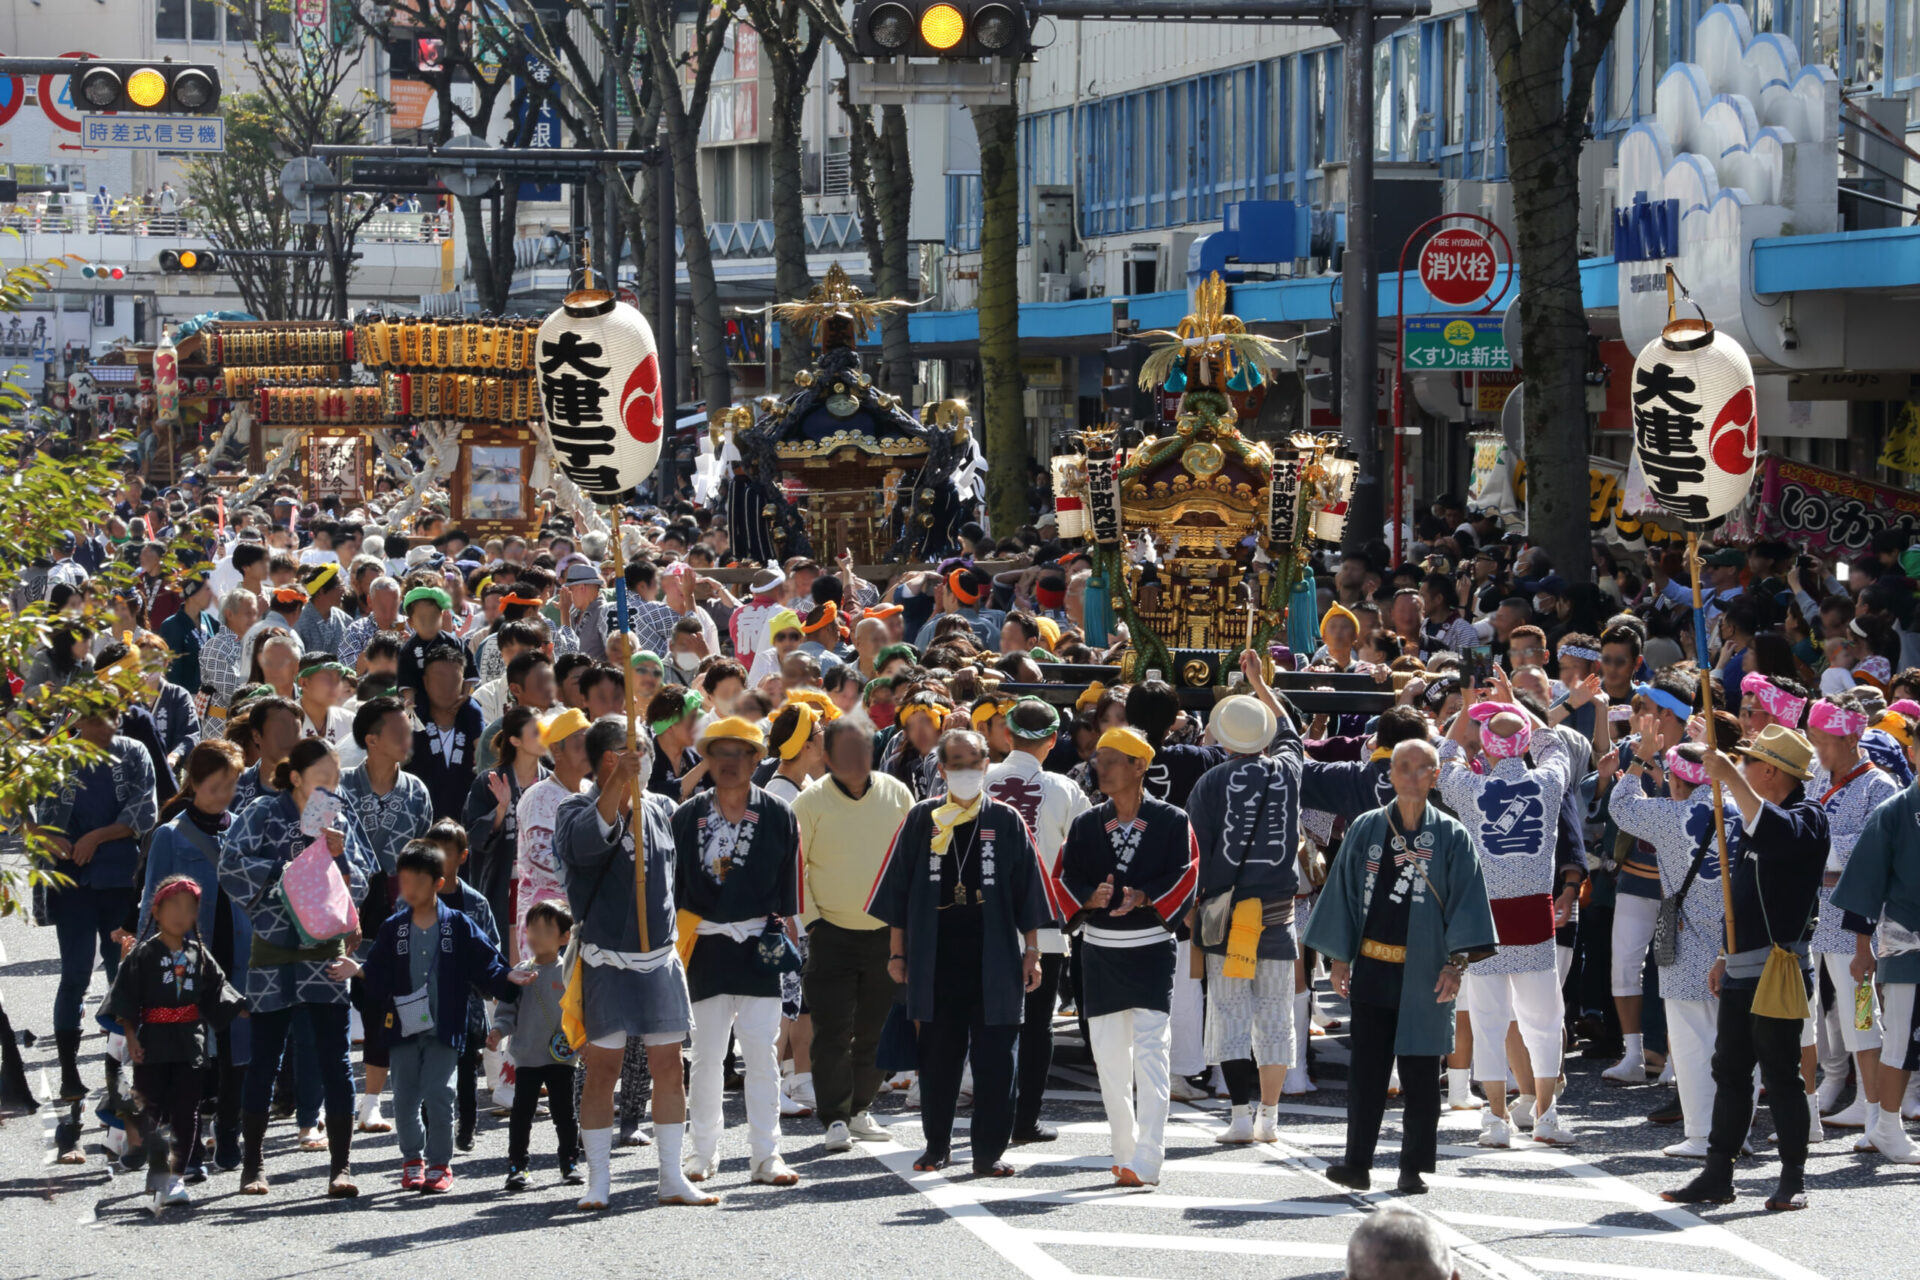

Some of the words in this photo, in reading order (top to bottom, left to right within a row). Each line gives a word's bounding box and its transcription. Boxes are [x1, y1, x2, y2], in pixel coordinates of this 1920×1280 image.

[89, 122, 217, 144] 時差式信号機
[1433, 238, 1449, 247] FIRE
[1451, 238, 1484, 248] HYDRANT
[1427, 251, 1491, 282] 消火栓
[540, 332, 621, 493] 大津一丁目
[1633, 363, 1709, 520] 大津一丁目
[980, 840, 996, 886] 大津一
